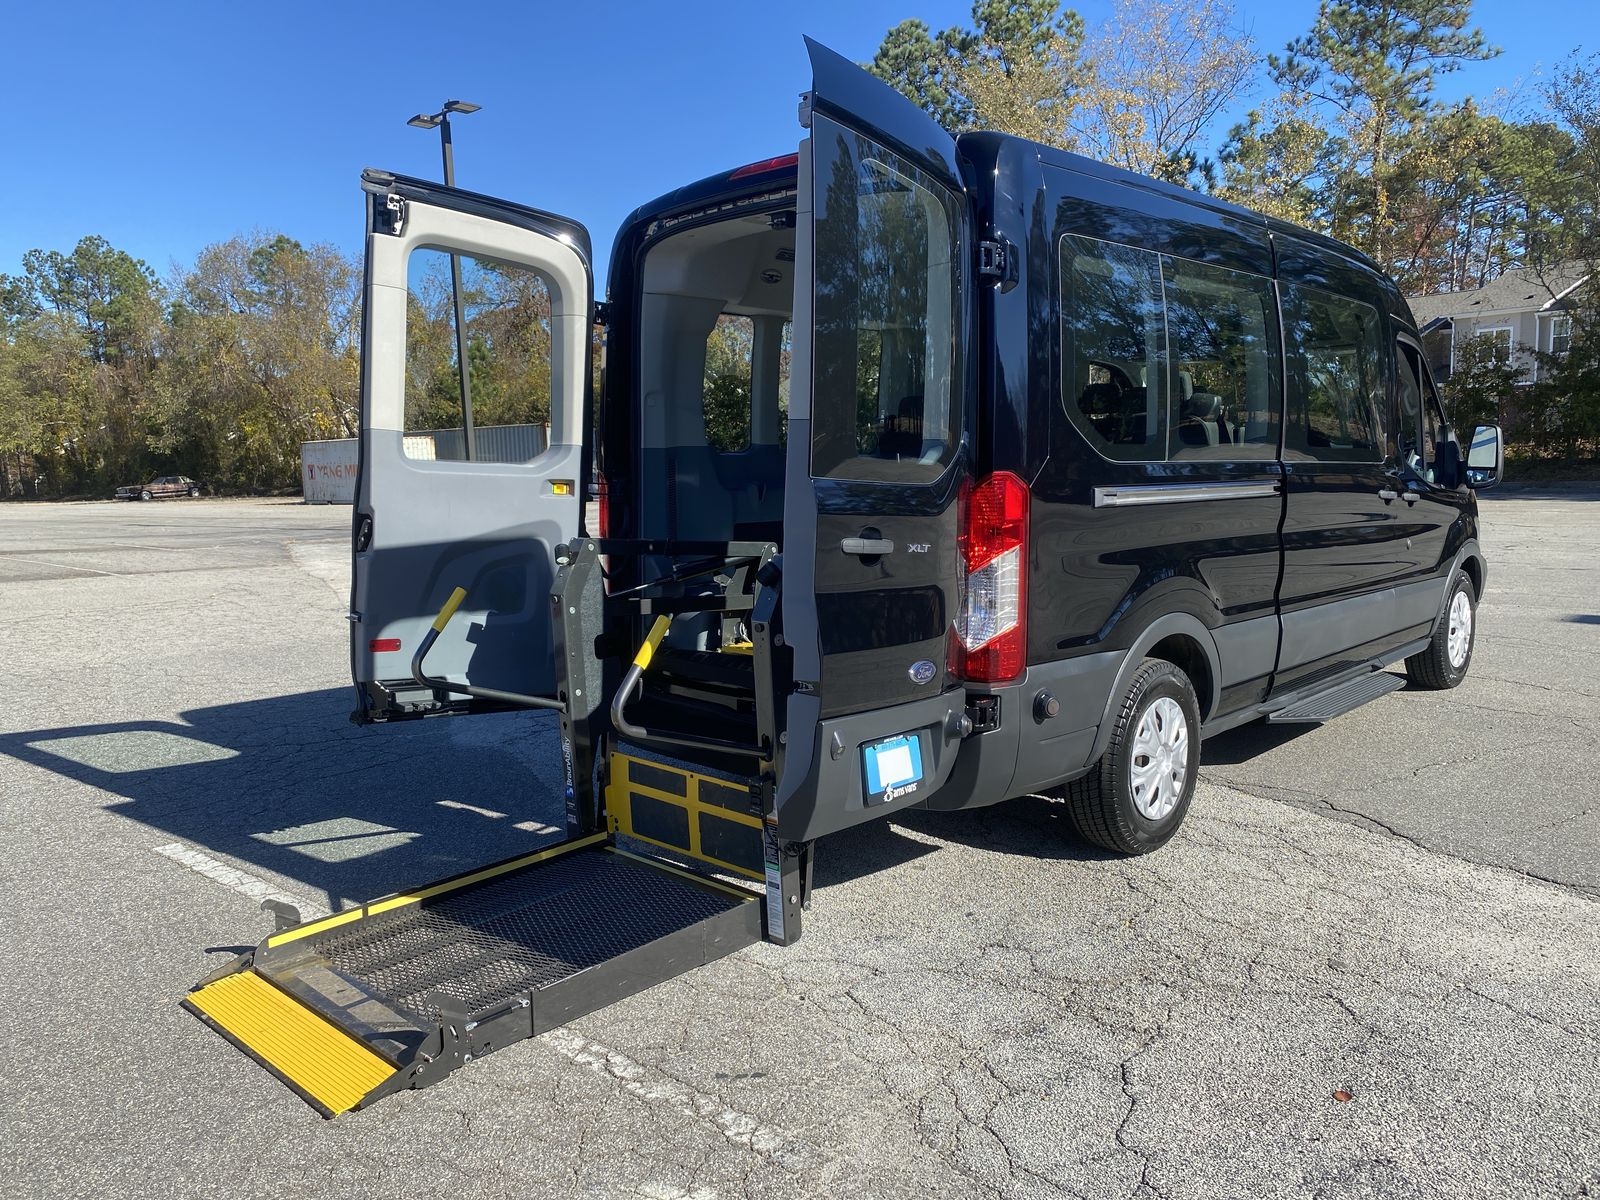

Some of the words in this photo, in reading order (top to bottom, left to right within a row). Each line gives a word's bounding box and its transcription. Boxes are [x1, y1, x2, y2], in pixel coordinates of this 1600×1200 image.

[317, 464, 342, 478] YANG
[907, 543, 931, 553] XLT
[562, 737, 573, 786] BraunAbility
